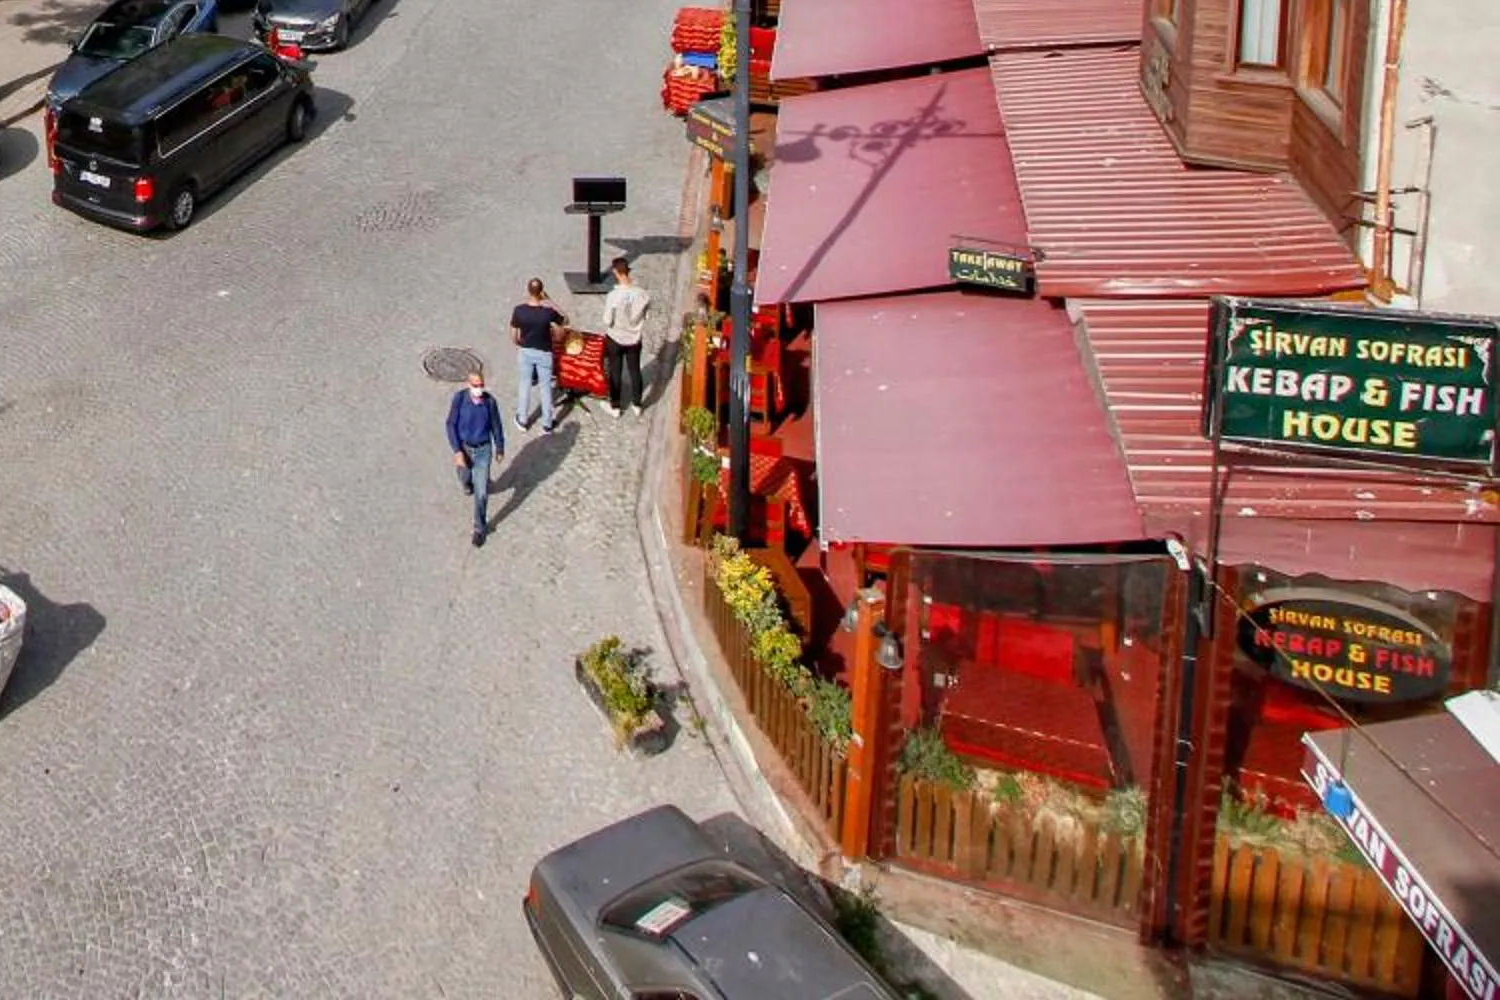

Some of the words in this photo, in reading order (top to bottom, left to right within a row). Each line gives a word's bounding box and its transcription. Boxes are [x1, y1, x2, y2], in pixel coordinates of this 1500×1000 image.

[987, 257, 1023, 272] AWAY
[1250, 326, 1348, 358] ŞİRVAN
[1356, 340, 1468, 369] SOFRASI
[1227, 366, 1352, 402] KEBAP
[1362, 378, 1390, 407] &
[1400, 381, 1486, 415] FISH
[1282, 410, 1418, 448] HOUSE
[1255, 629, 1342, 658] KEBAP
[1348, 643, 1367, 664] &
[1376, 648, 1436, 677] FISH
[1343, 620, 1423, 646] SOFRASI
[1291, 659, 1392, 694] HOUSE
[1395, 866, 1495, 1000] SOFRASI
